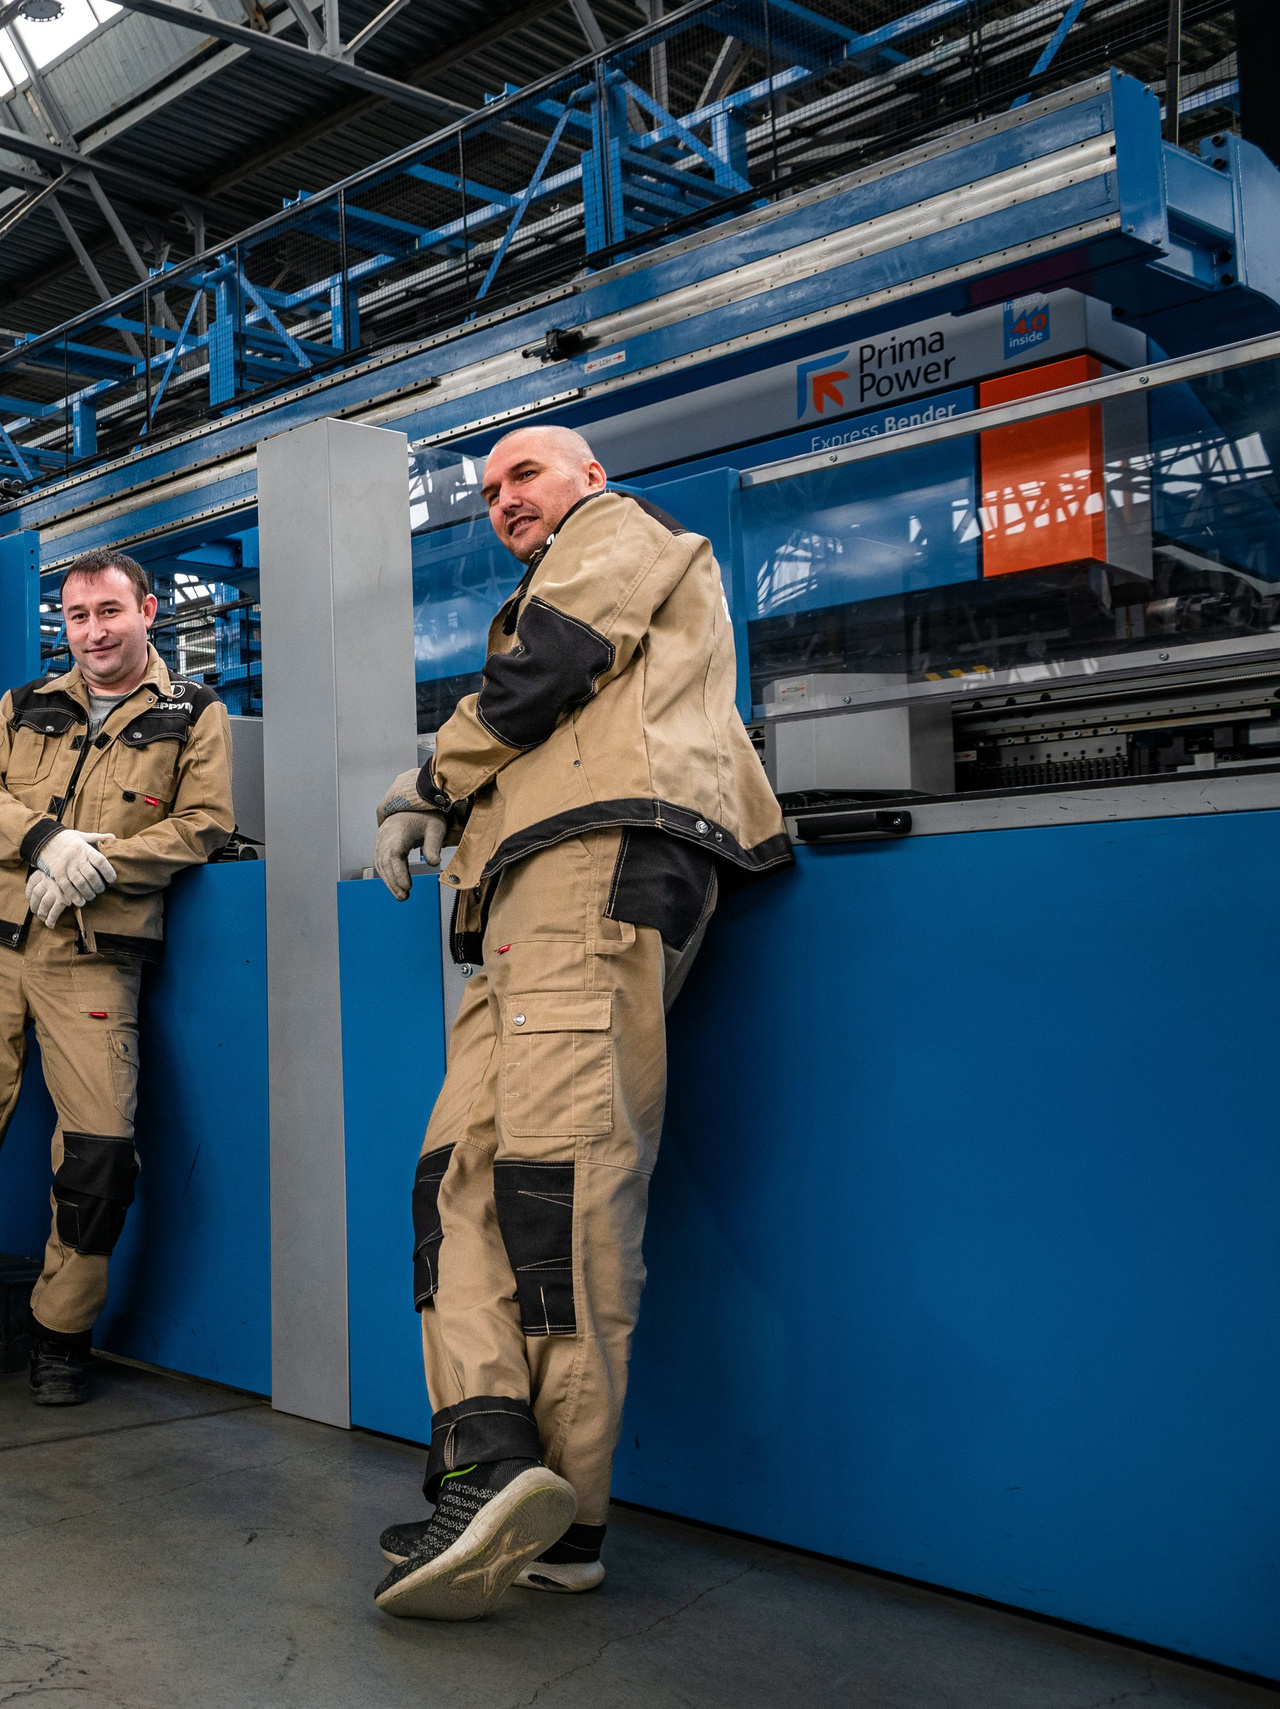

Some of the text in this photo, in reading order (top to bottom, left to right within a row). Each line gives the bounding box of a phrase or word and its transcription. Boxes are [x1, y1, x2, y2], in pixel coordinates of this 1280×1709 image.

[1009, 330, 1043, 348] inside
[1012, 313, 1047, 335] 4.0
[859, 331, 945, 374] Prima
[859, 356, 956, 403] Power
[811, 403, 957, 452] Express Bender
[151, 702, 193, 713] ЕРРУ
